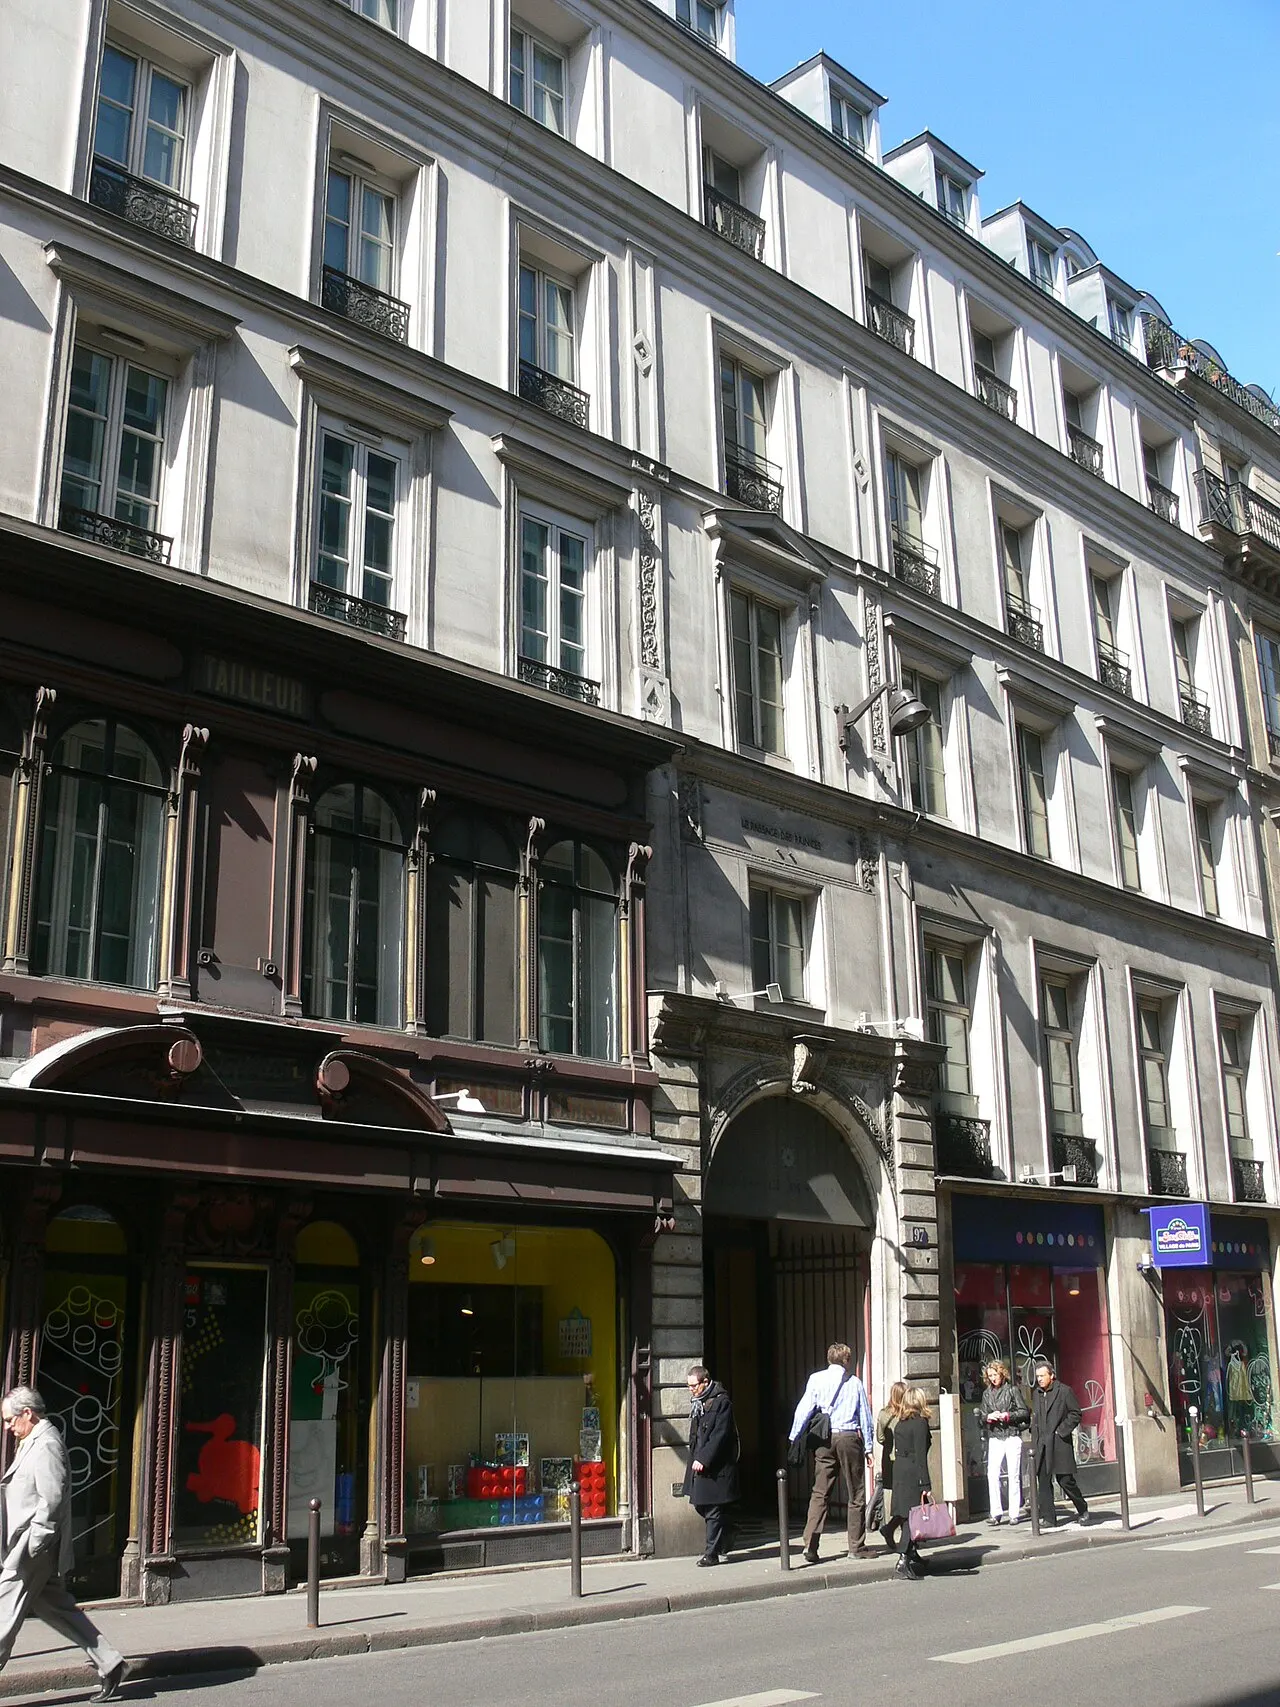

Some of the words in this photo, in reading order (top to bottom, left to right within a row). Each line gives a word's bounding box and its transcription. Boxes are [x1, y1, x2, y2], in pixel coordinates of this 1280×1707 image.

[204, 654, 303, 715] TAILLEUR
[913, 1227, 925, 1242] 97
[1158, 1242, 1179, 1250] VILLAGE
